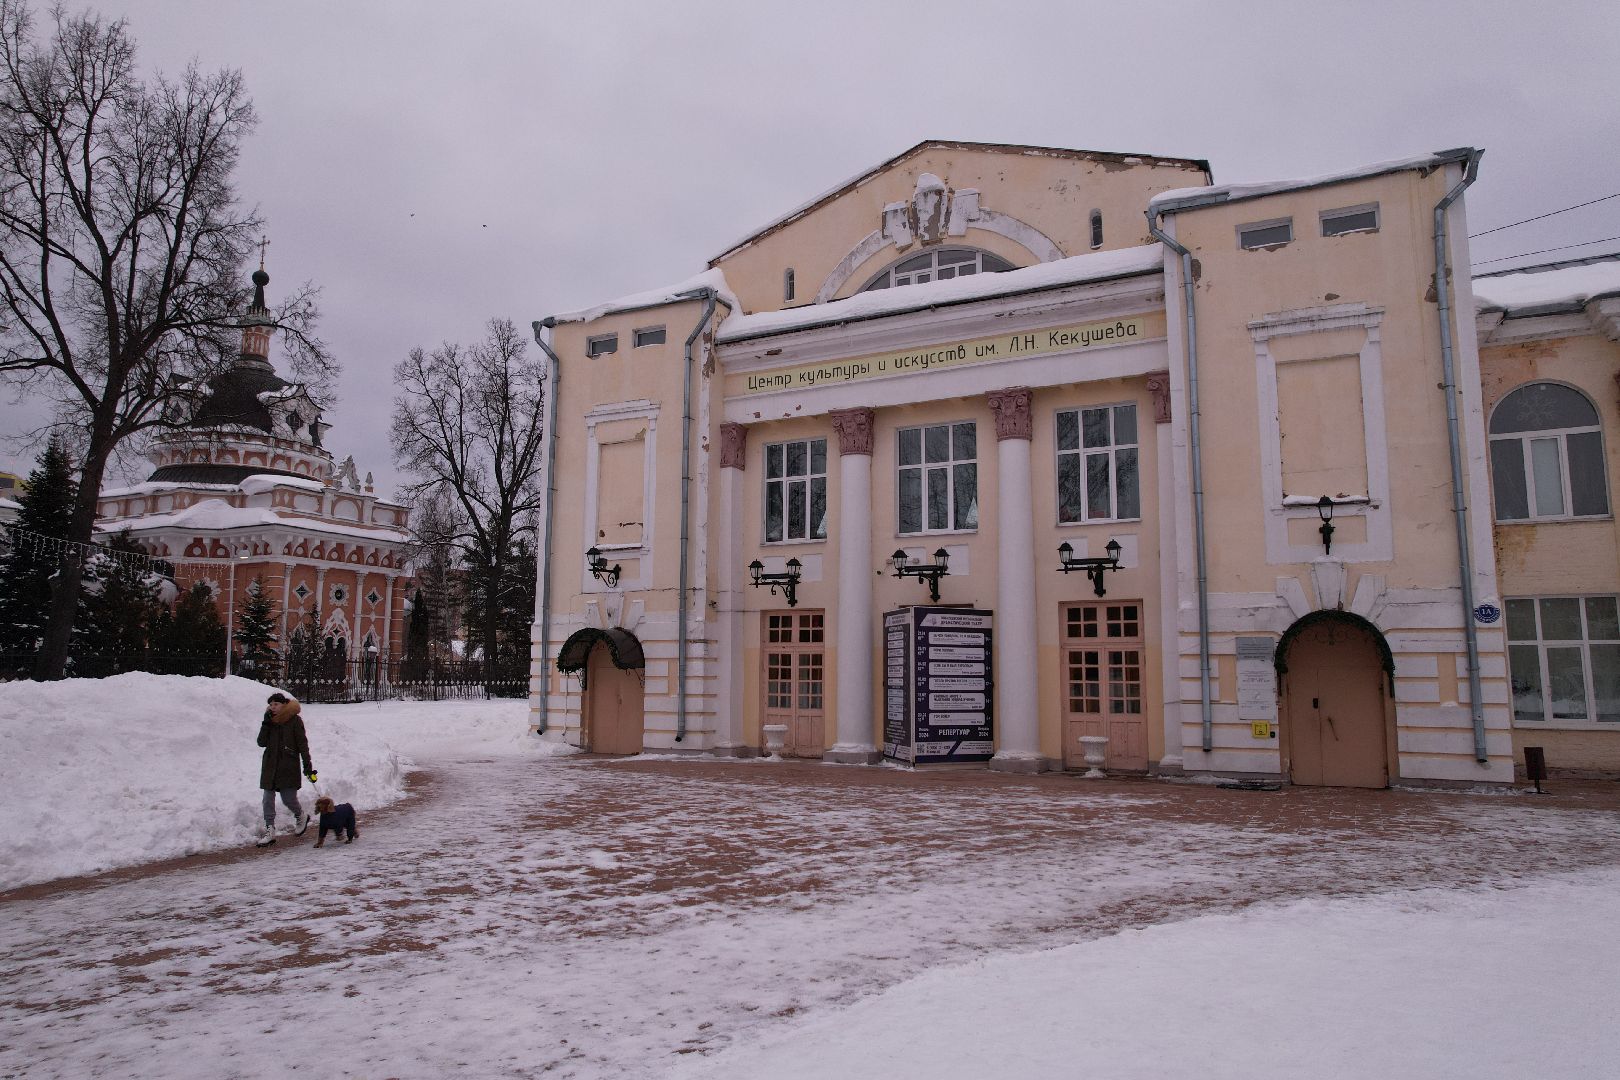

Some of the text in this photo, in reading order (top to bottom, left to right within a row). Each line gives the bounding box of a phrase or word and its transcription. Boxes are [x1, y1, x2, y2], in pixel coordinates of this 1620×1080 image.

[748, 321, 1138, 391] Центр культуры и искусств им. Л.Н. Кекушева
[938, 728, 971, 736] РЕПЕРТУАР
